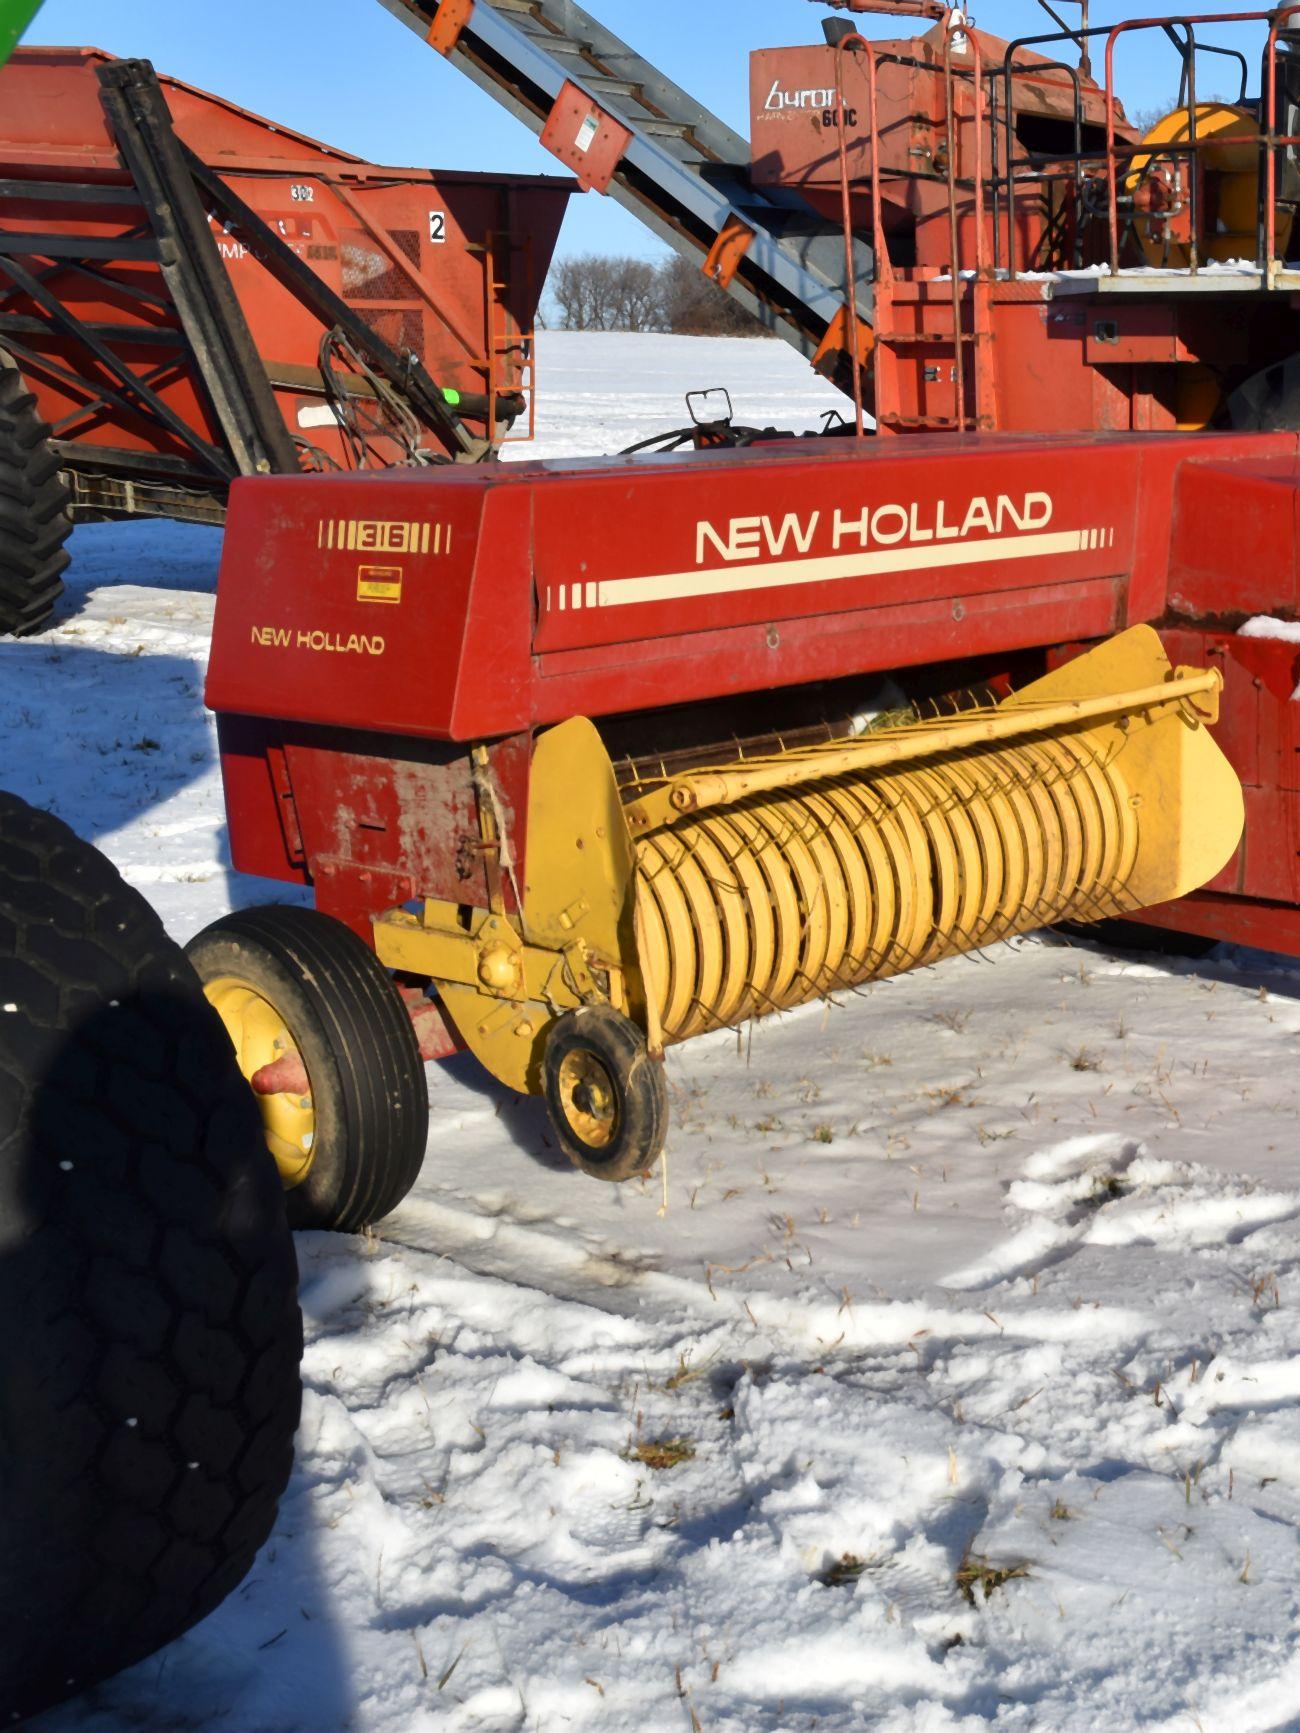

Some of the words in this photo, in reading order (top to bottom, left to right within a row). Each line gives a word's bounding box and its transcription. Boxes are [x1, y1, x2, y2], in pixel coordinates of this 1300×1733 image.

[431, 214, 444, 240] 2
[361, 523, 405, 549] 316
[696, 510, 820, 563] NEW
[832, 491, 1053, 550] HOLLAND
[251, 625, 292, 648] NEW
[296, 630, 385, 655] HOLLAND
